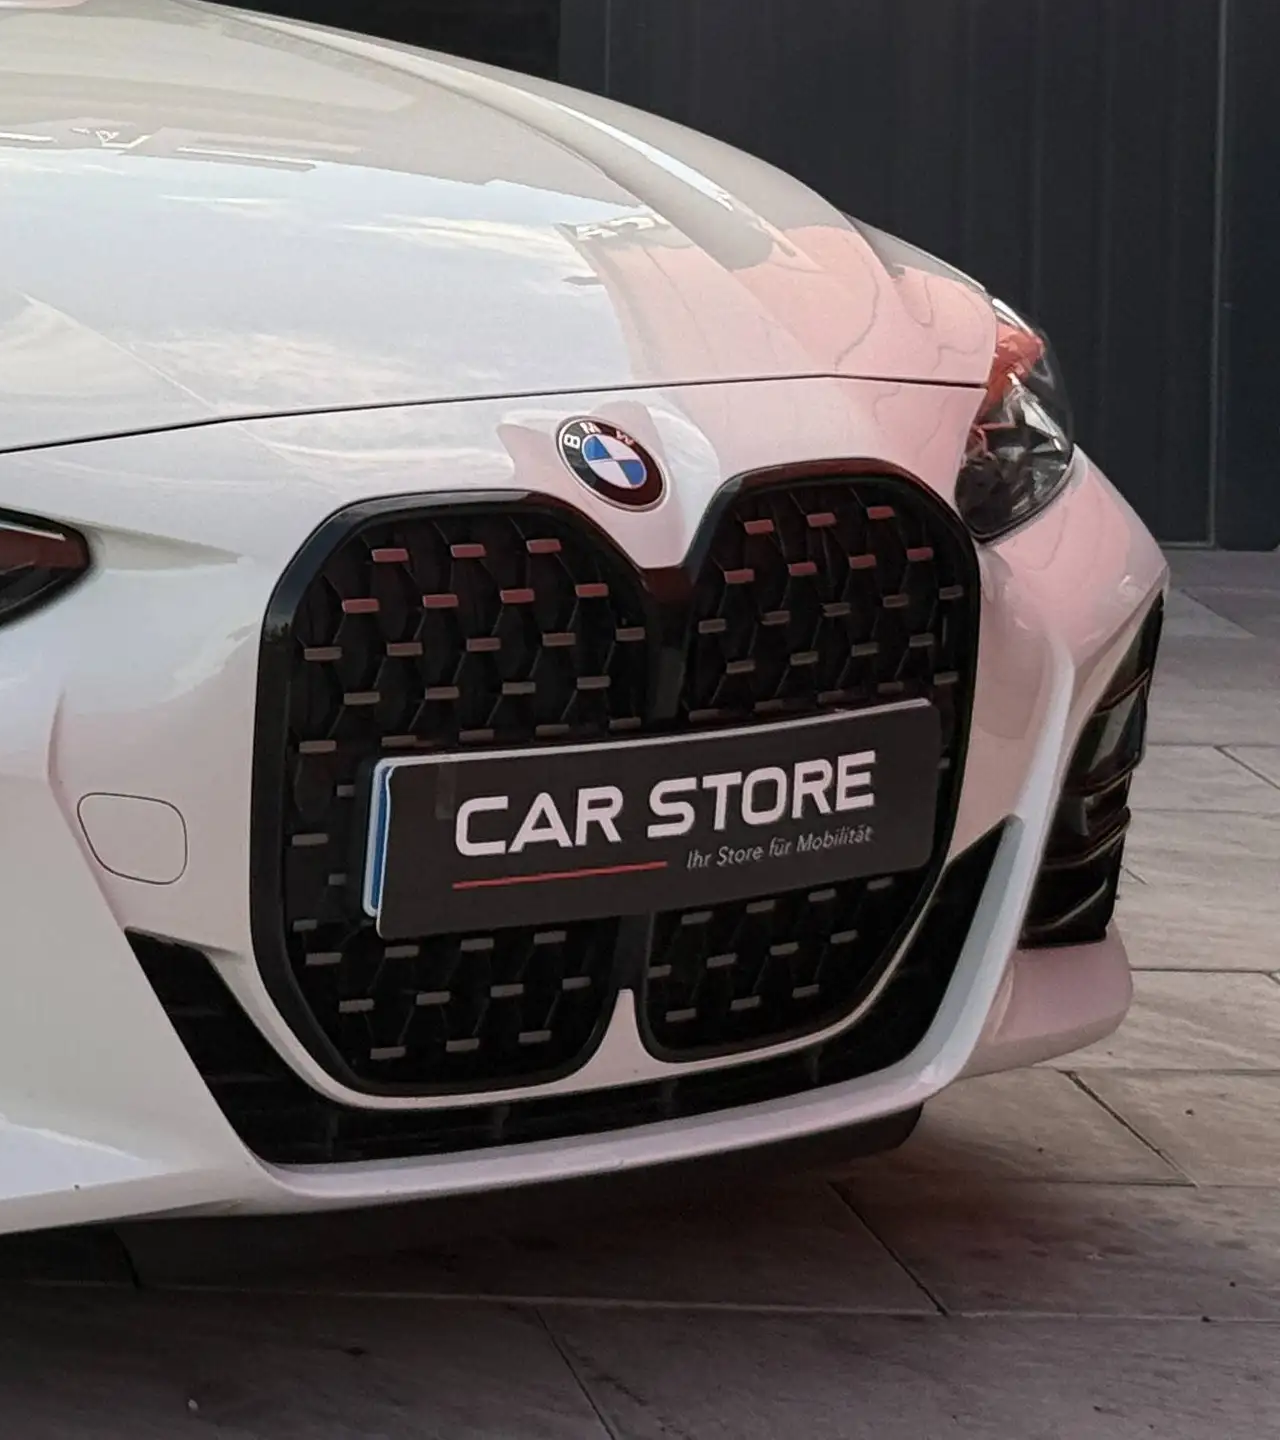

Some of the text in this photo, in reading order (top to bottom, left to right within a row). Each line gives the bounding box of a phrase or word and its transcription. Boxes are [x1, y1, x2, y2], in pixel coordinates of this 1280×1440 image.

[563, 421, 635, 450] BMW
[454, 750, 877, 858] CAR STORE
[686, 824, 875, 869] Ihr Store für Mobilität
